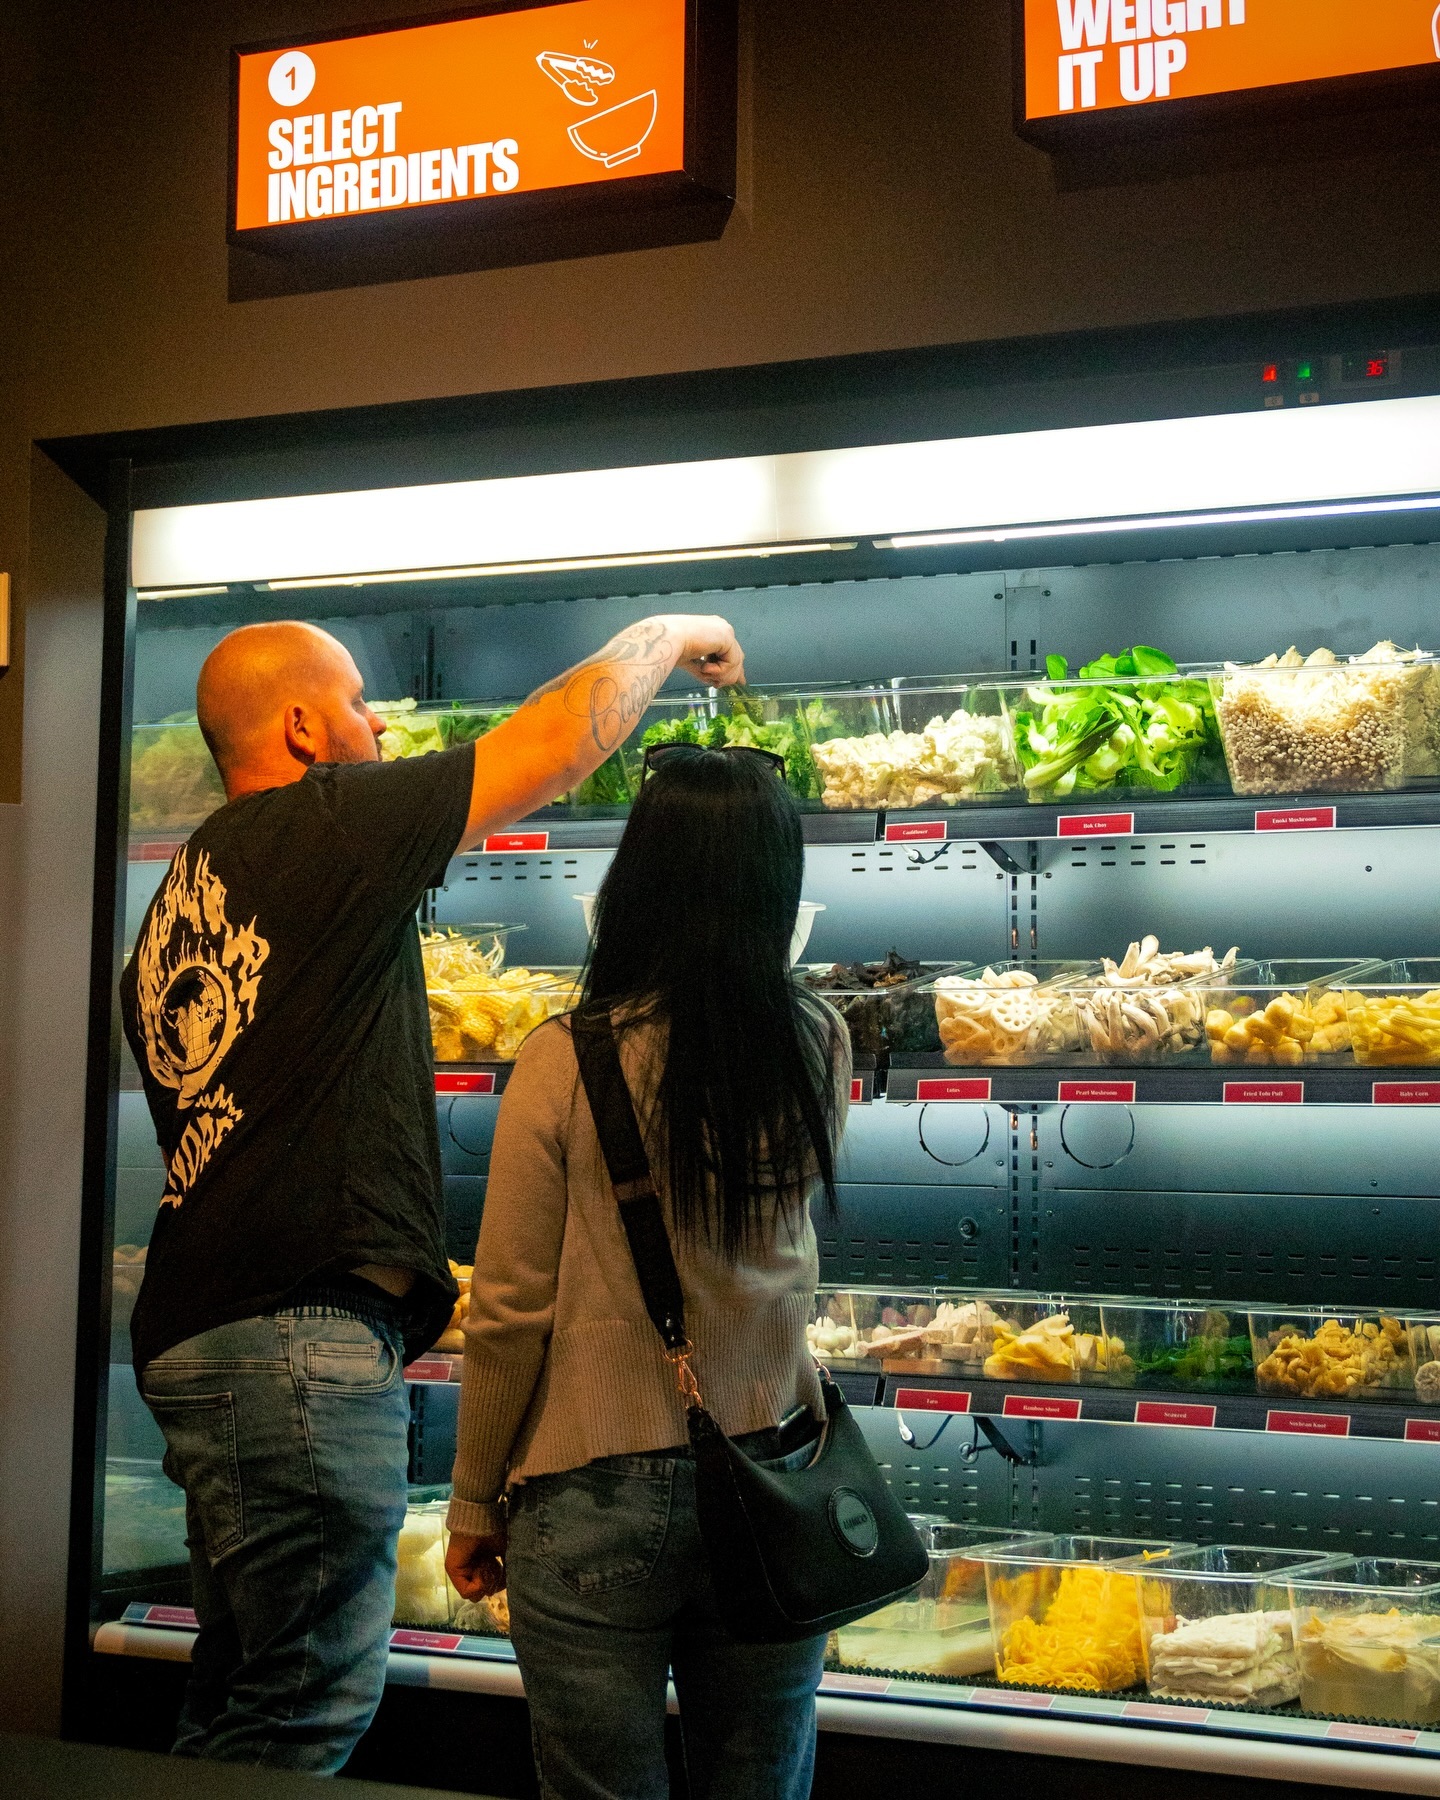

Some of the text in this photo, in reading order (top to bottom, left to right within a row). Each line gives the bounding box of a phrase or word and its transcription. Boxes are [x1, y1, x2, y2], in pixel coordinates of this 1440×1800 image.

[285, 66, 296, 91] 1
[1058, 38, 1187, 111] IT UP
[267, 101, 402, 170] SELECT
[267, 138, 519, 223] INGREDIENTS
